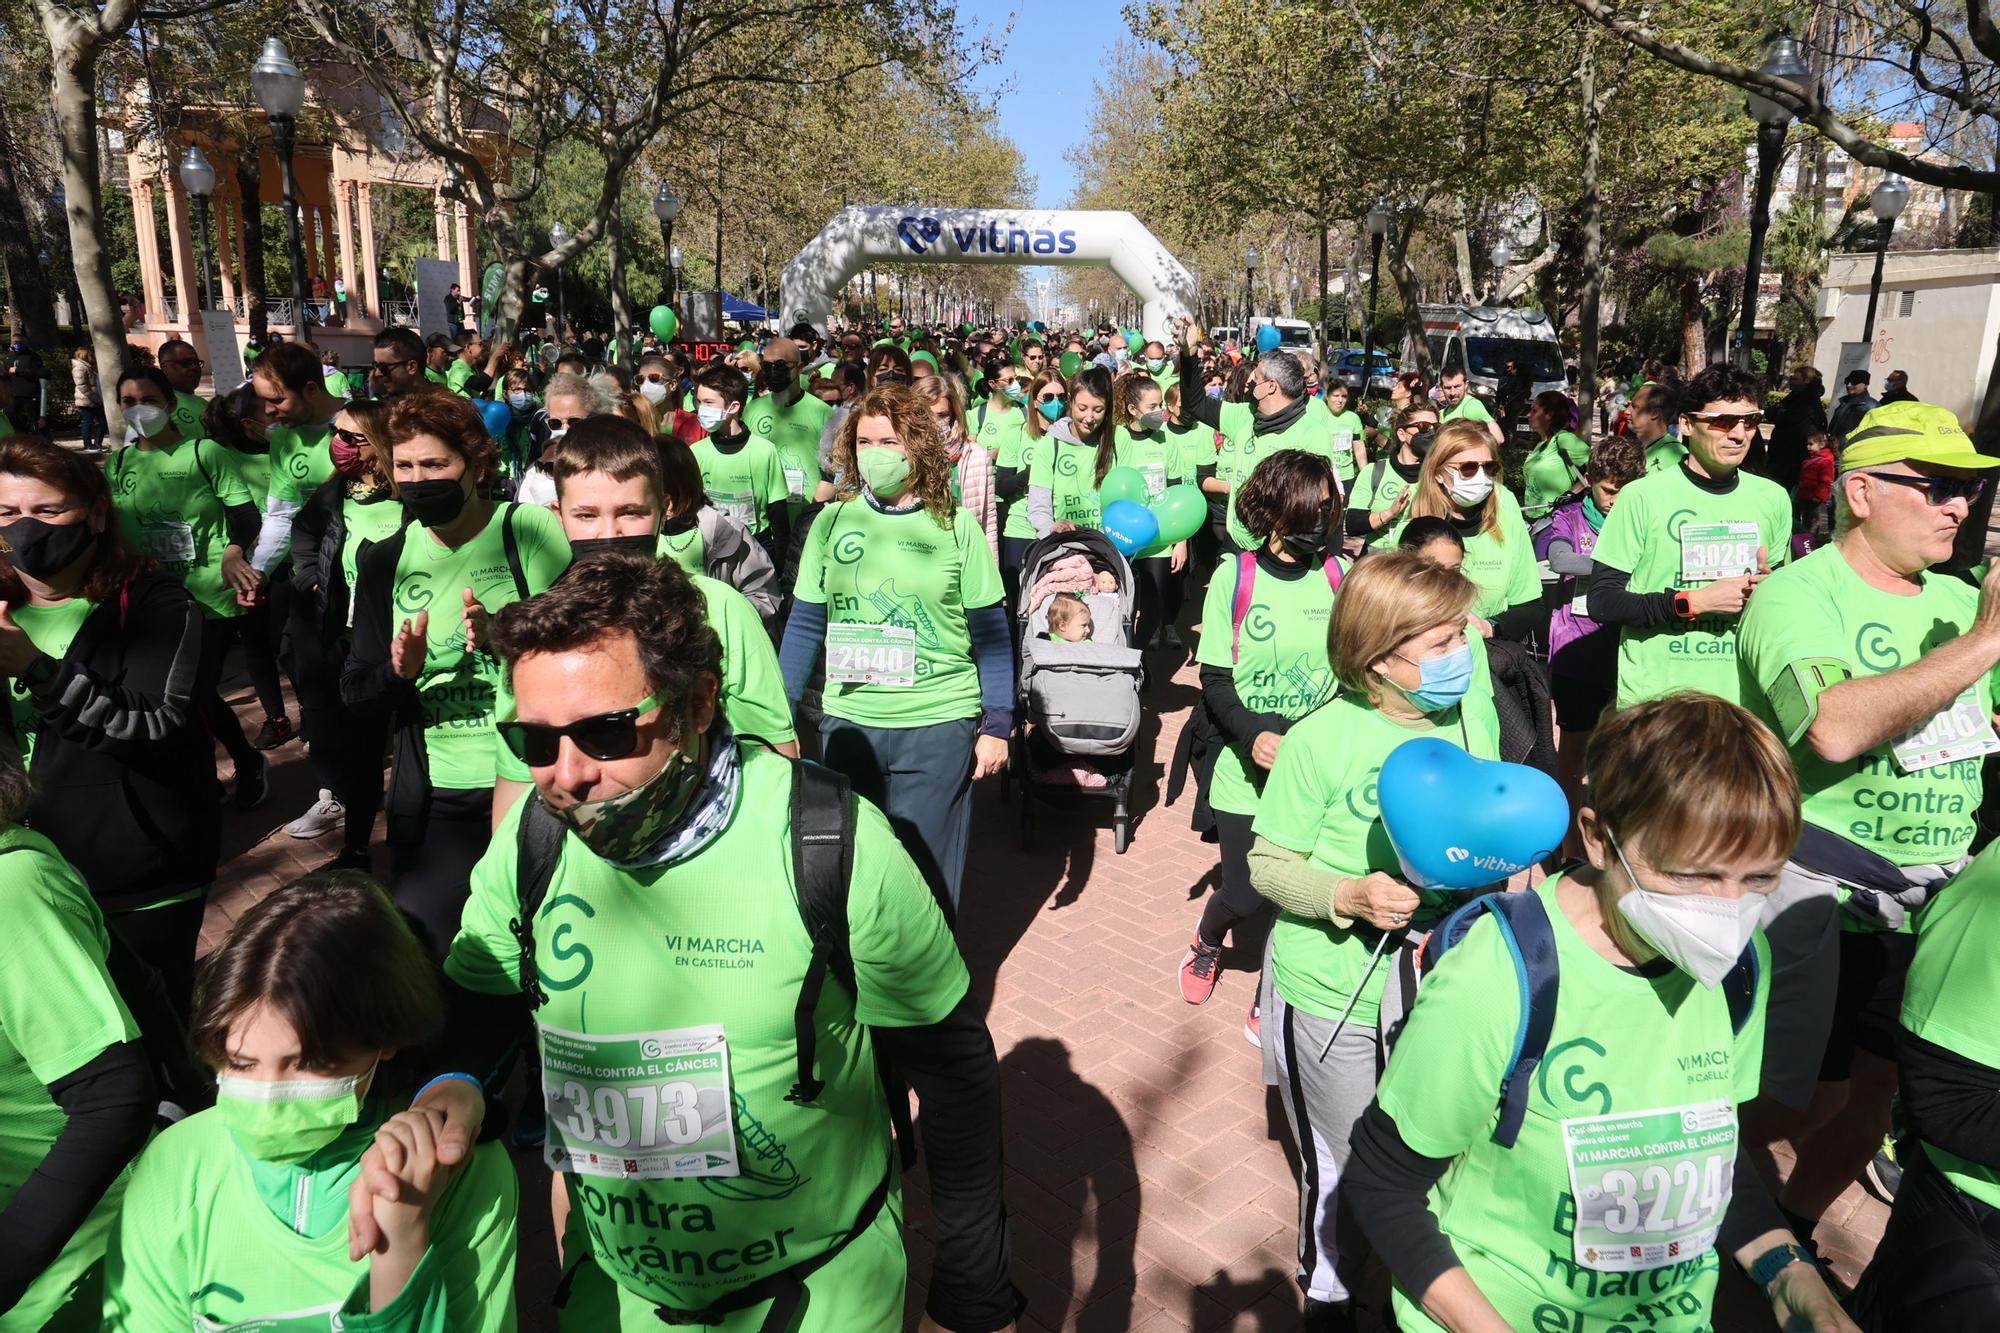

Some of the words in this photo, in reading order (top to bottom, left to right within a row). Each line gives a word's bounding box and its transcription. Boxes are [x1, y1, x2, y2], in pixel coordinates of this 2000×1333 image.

[953, 220, 1077, 254] vithas
[484, 268, 505, 301] SUMA
[1064, 494, 1080, 507] En
[1065, 507, 1099, 521] marc
[906, 541, 938, 551] MARCHA
[1111, 530, 1133, 545] vithas
[1692, 543, 1750, 568] 3028
[480, 565, 513, 576] MARCH
[833, 592, 859, 611] En
[1669, 636, 1691, 654] el
[1695, 636, 1735, 655] cán
[839, 646, 904, 673] 2640
[1253, 670, 1276, 688] En
[1247, 688, 1314, 709] march
[1853, 787, 1965, 814] contra
[1850, 816, 1884, 842] el
[1473, 855, 1526, 873] vithas
[665, 935, 682, 951] VI
[687, 936, 765, 954] MARCHA
[675, 956, 689, 966] EN
[692, 957, 754, 969] CASTELLÓN
[553, 1059, 594, 1077] MARCHA
[594, 1067, 645, 1078] CONTRA
[647, 1063, 663, 1075] EL
[665, 1057, 718, 1073] CÁNCER
[564, 1081, 705, 1148] 3973
[1576, 1152, 1589, 1163] VI
[1590, 1147, 1644, 1162] MARCHA
[1645, 1141, 1687, 1156] CONTRA
[1687, 1138, 1700, 1149] EL
[1702, 1130, 1735, 1147] CÁNCER
[1602, 1156, 1723, 1234] 3224
[1553, 1191, 1577, 1239] E
